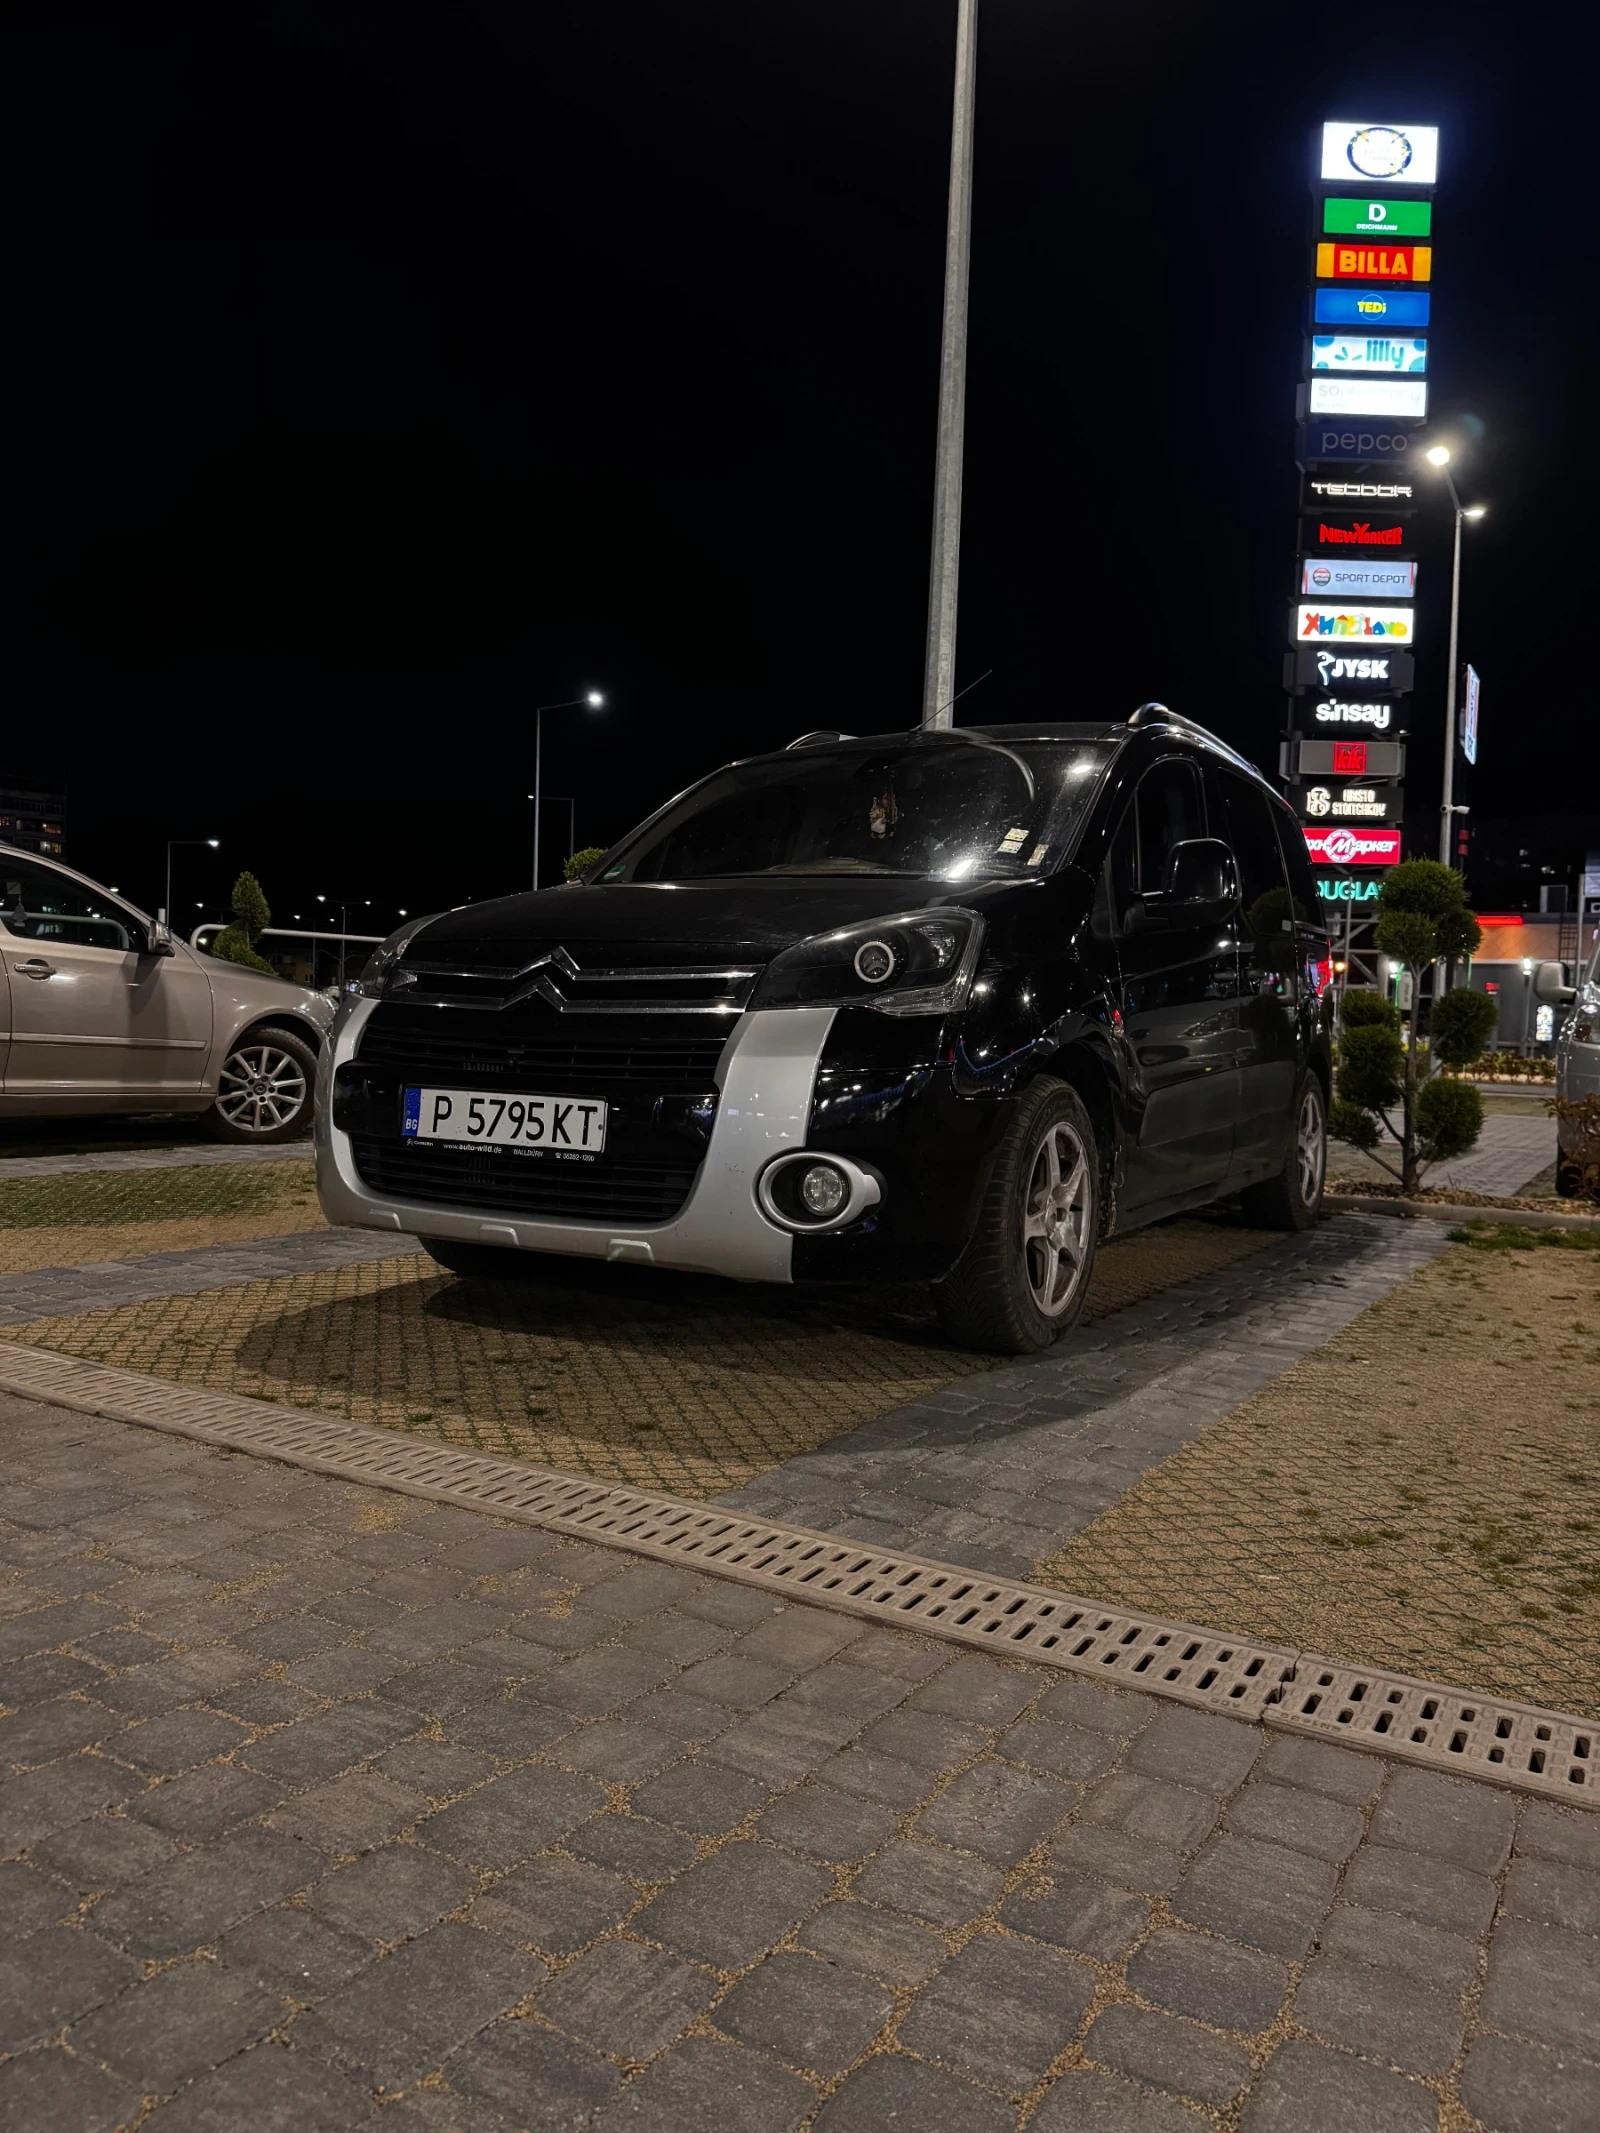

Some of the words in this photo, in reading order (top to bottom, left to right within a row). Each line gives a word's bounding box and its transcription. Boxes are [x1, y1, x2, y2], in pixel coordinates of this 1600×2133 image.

[1368, 203, 1386, 222] D
[1356, 223, 1398, 231] DEICHMANN
[1339, 250, 1408, 275] BILLA
[1357, 301, 1387, 313] TEDi
[1366, 340, 1405, 369] lilly
[1321, 432, 1408, 454] pepco
[1311, 482, 1413, 498] TEODOR
[1335, 573, 1370, 583] SPORT
[1372, 574, 1408, 584] DEPOT
[1331, 659, 1389, 679] JYSK
[1316, 698, 1390, 729] sinsay
[1342, 788, 1376, 803] HRISTO
[1331, 802, 1387, 816] STOITCHKOV
[432, 1095, 452, 1133] P
[405, 1119, 418, 1131] BG
[443, 1143, 502, 1154] www.auto-wild.de
